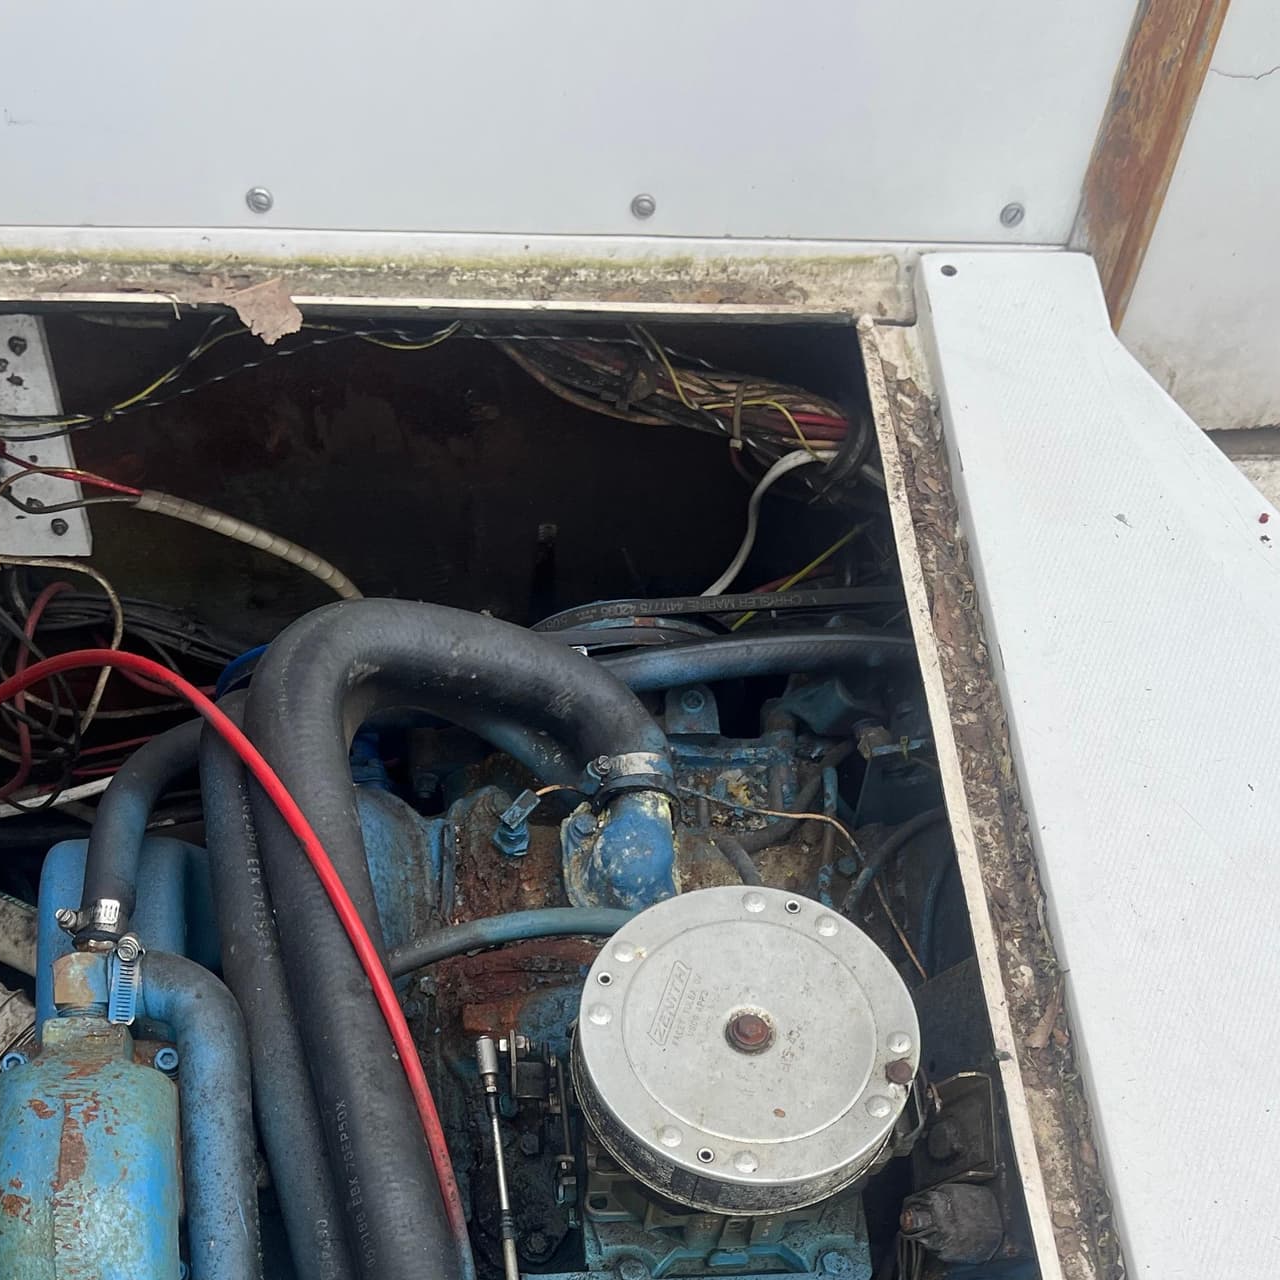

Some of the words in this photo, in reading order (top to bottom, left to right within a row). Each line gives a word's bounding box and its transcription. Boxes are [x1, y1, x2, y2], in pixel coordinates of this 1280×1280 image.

[687, 597, 735, 609] MARINE
[737, 594, 801, 609] CHRYSLER
[652, 964, 686, 1042] ZENITH
